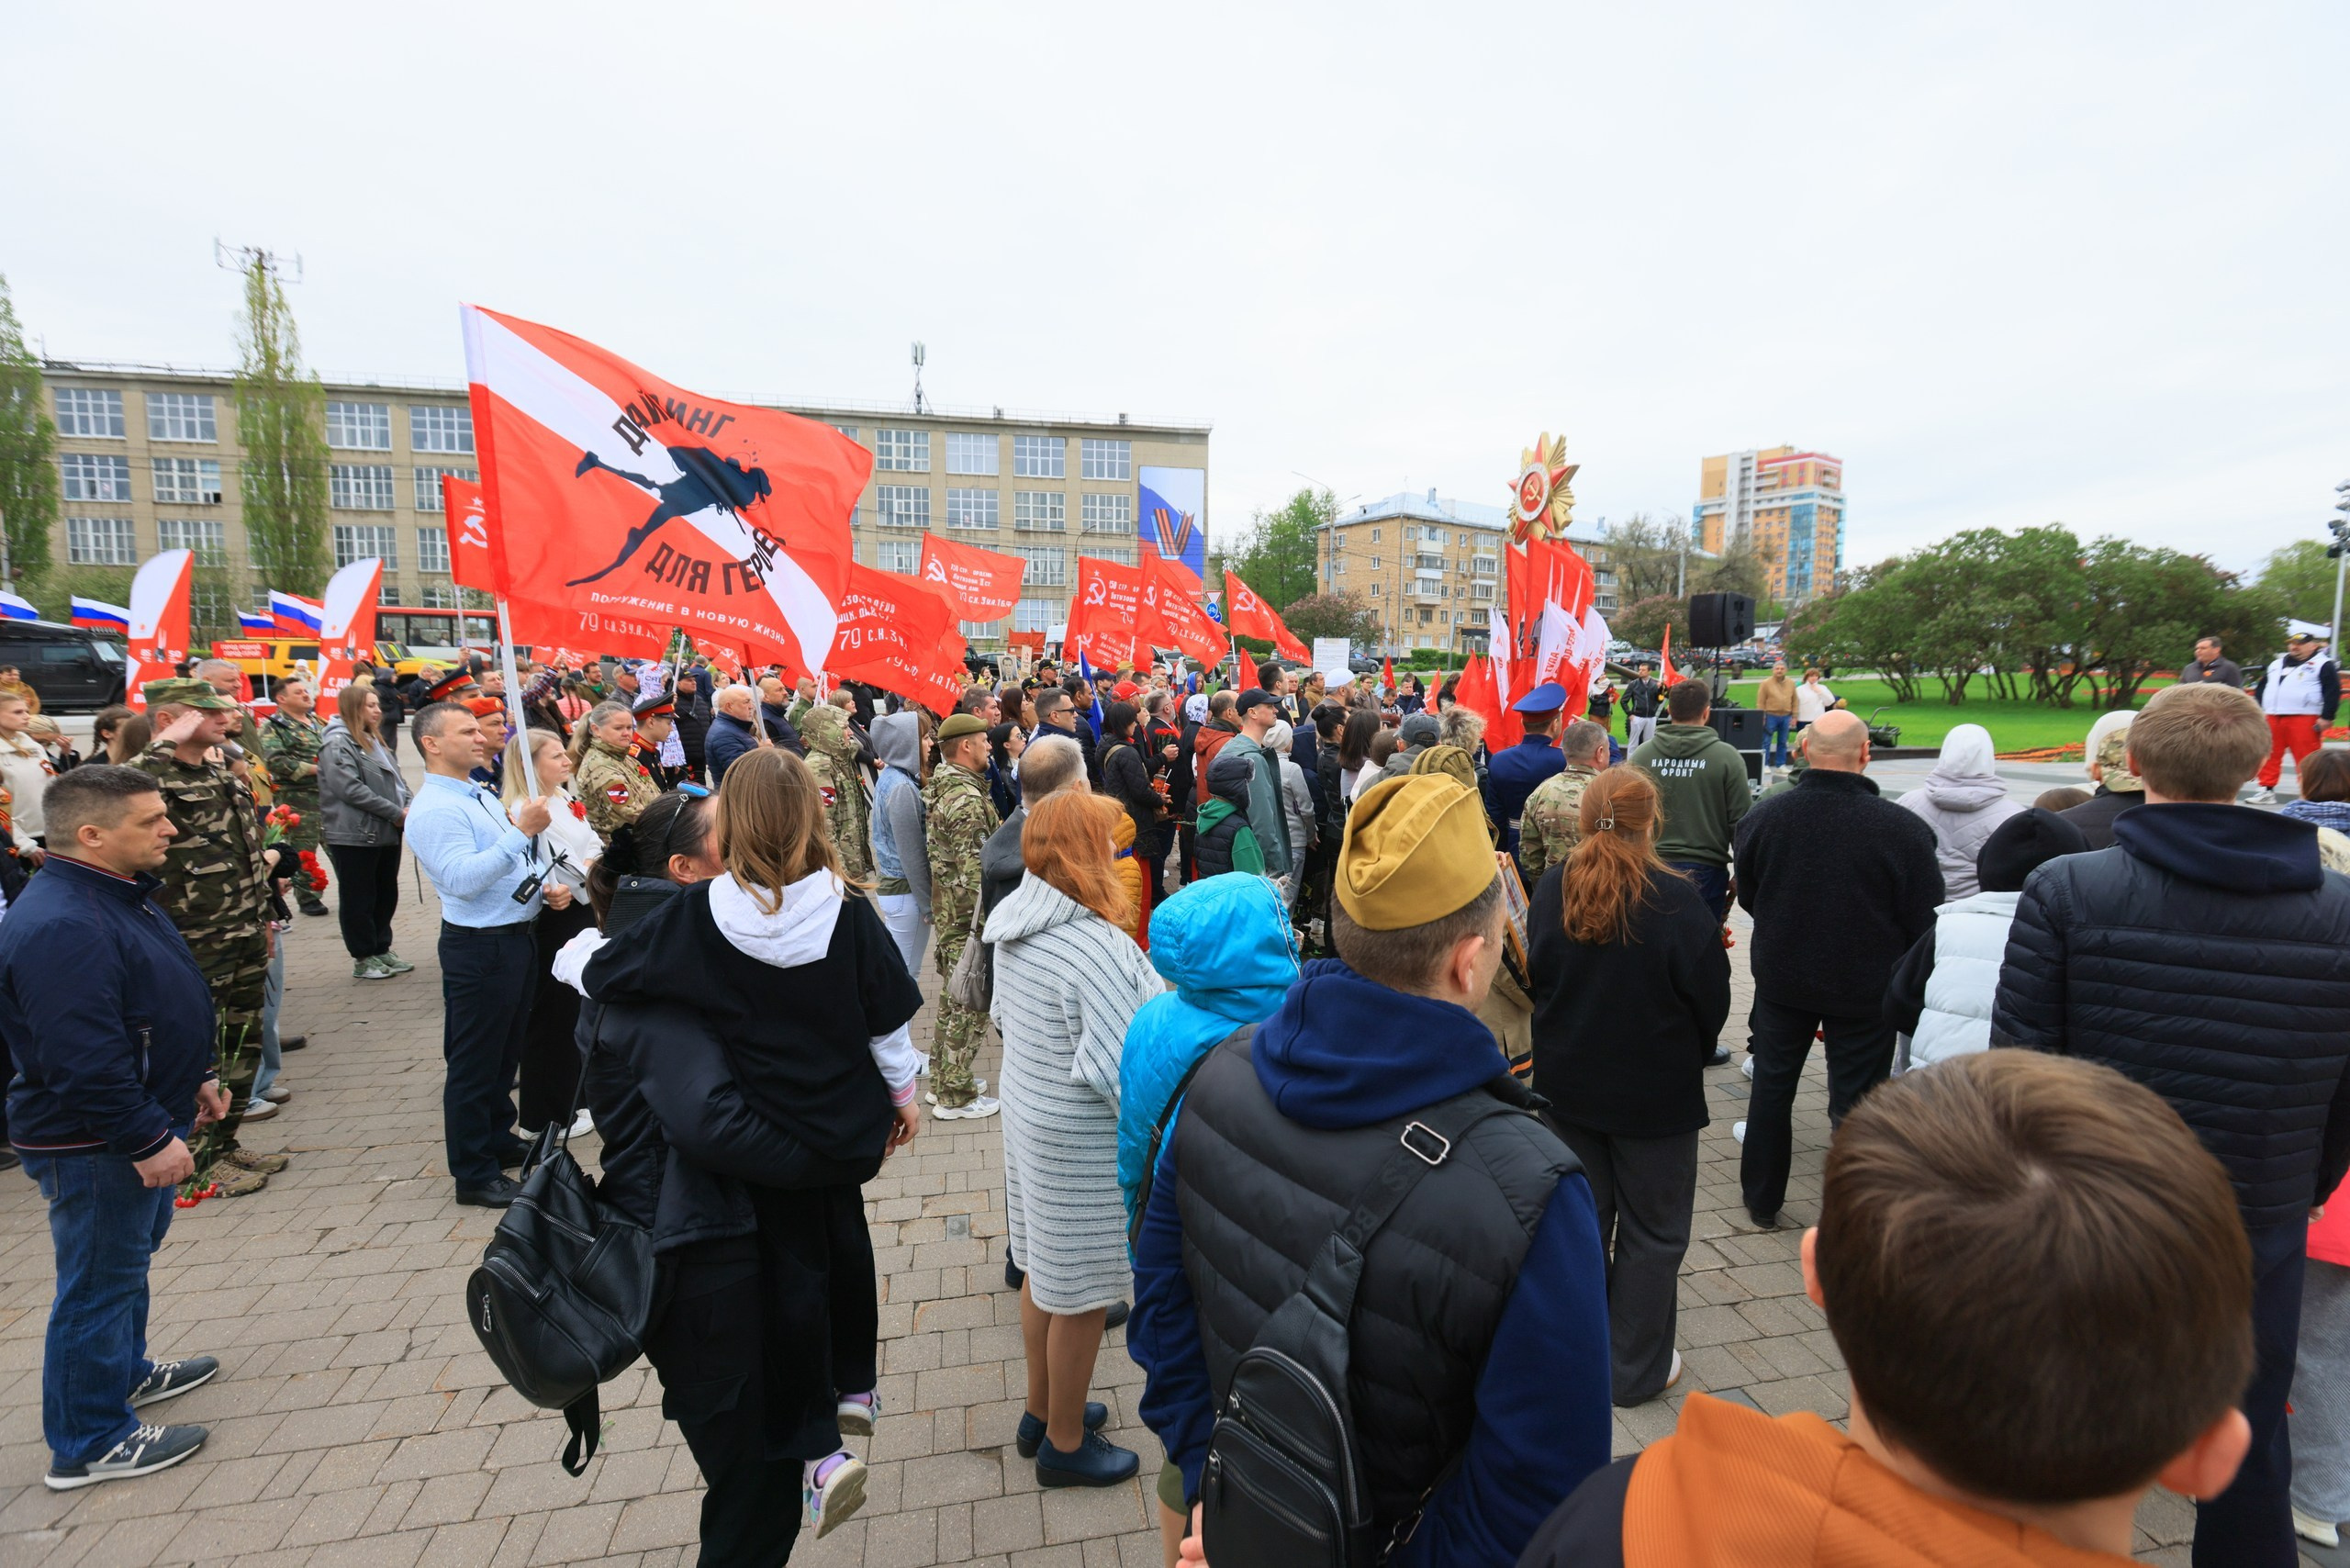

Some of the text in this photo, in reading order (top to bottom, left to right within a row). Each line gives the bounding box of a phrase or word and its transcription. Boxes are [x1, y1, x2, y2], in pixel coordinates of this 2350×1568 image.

[612, 389, 736, 456] ДАЙИНГ
[644, 541, 711, 595] ДЛЯ
[578, 611, 599, 633] 79
[681, 607, 689, 616] В
[697, 610, 749, 628] НОВУЮ
[753, 622, 786, 645] ЖИЗНЬ
[839, 627, 861, 651] 79
[1545, 652, 1560, 672] ТУЛА
[1651, 758, 1707, 770] НАРОДНЫЙ
[1661, 767, 1695, 778] ФРОНТ
